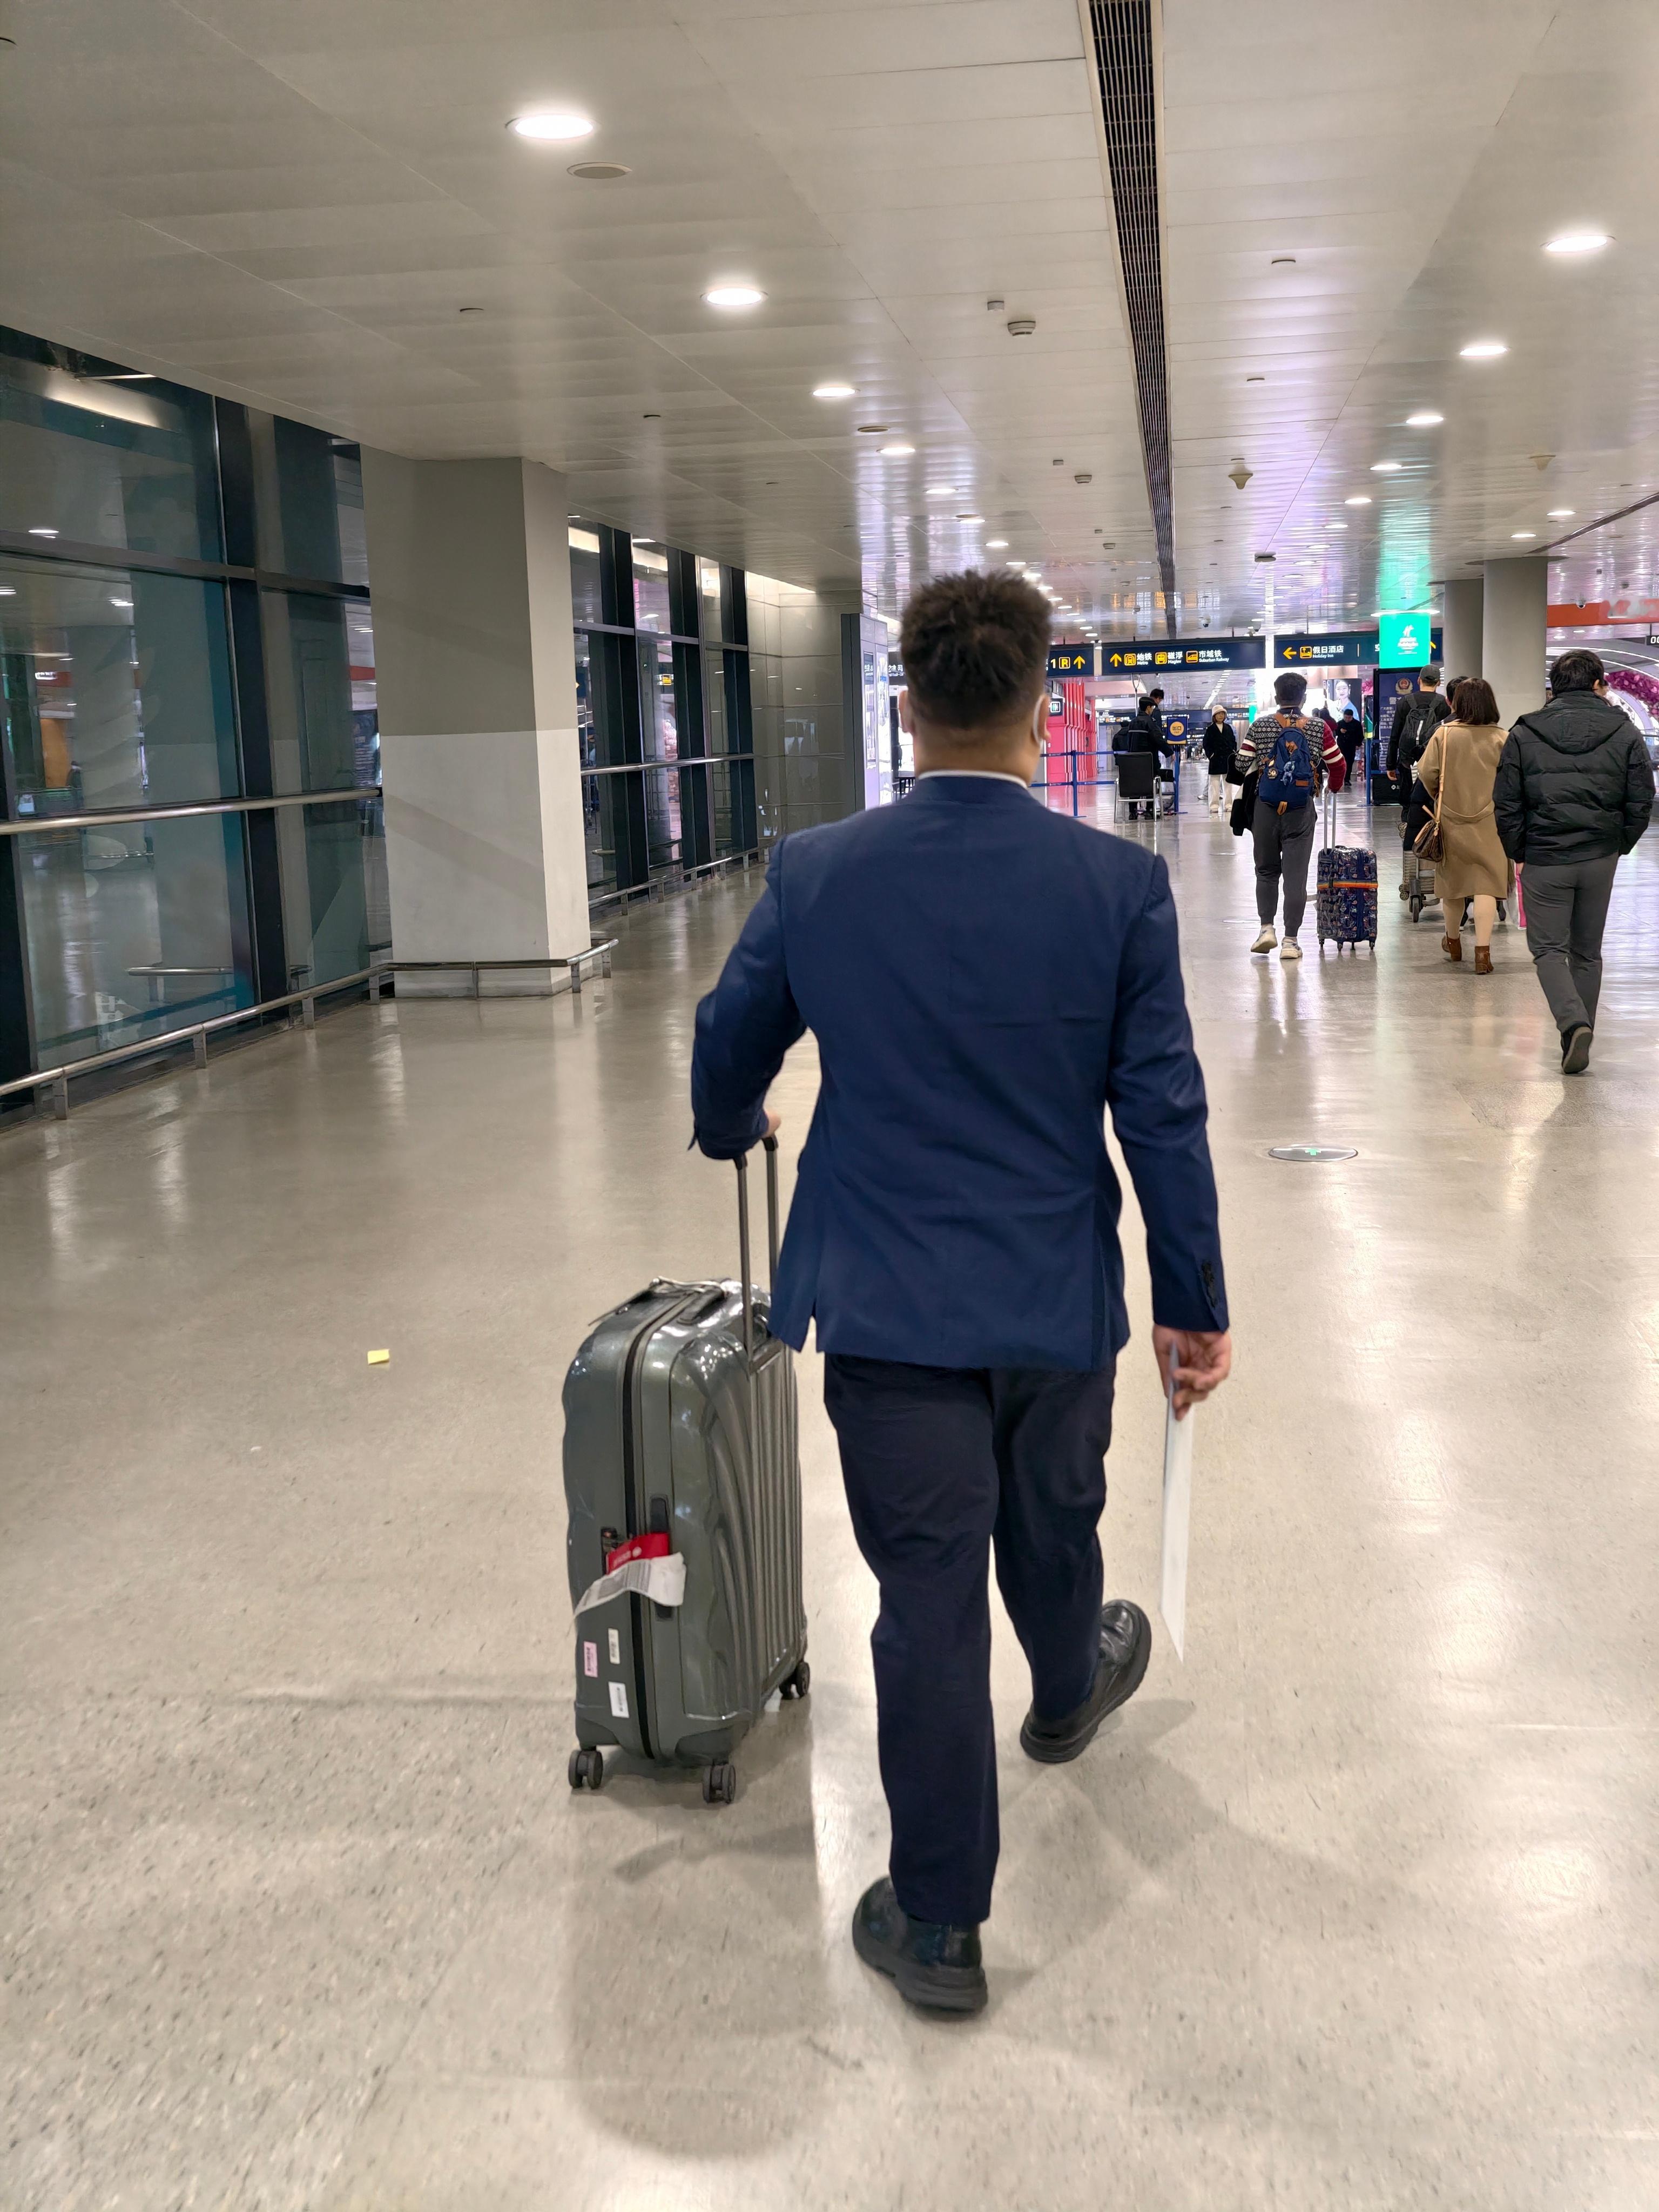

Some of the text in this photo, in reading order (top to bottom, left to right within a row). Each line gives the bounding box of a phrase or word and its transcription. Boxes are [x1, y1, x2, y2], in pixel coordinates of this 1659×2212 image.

[1313, 645, 1344, 654] 假日酒店
[1137, 652, 1152, 660] 地铁
[1168, 651, 1183, 659] 磁浮
[1199, 650, 1222, 658] 市域铁
[1050, 658, 1056, 669] 1
